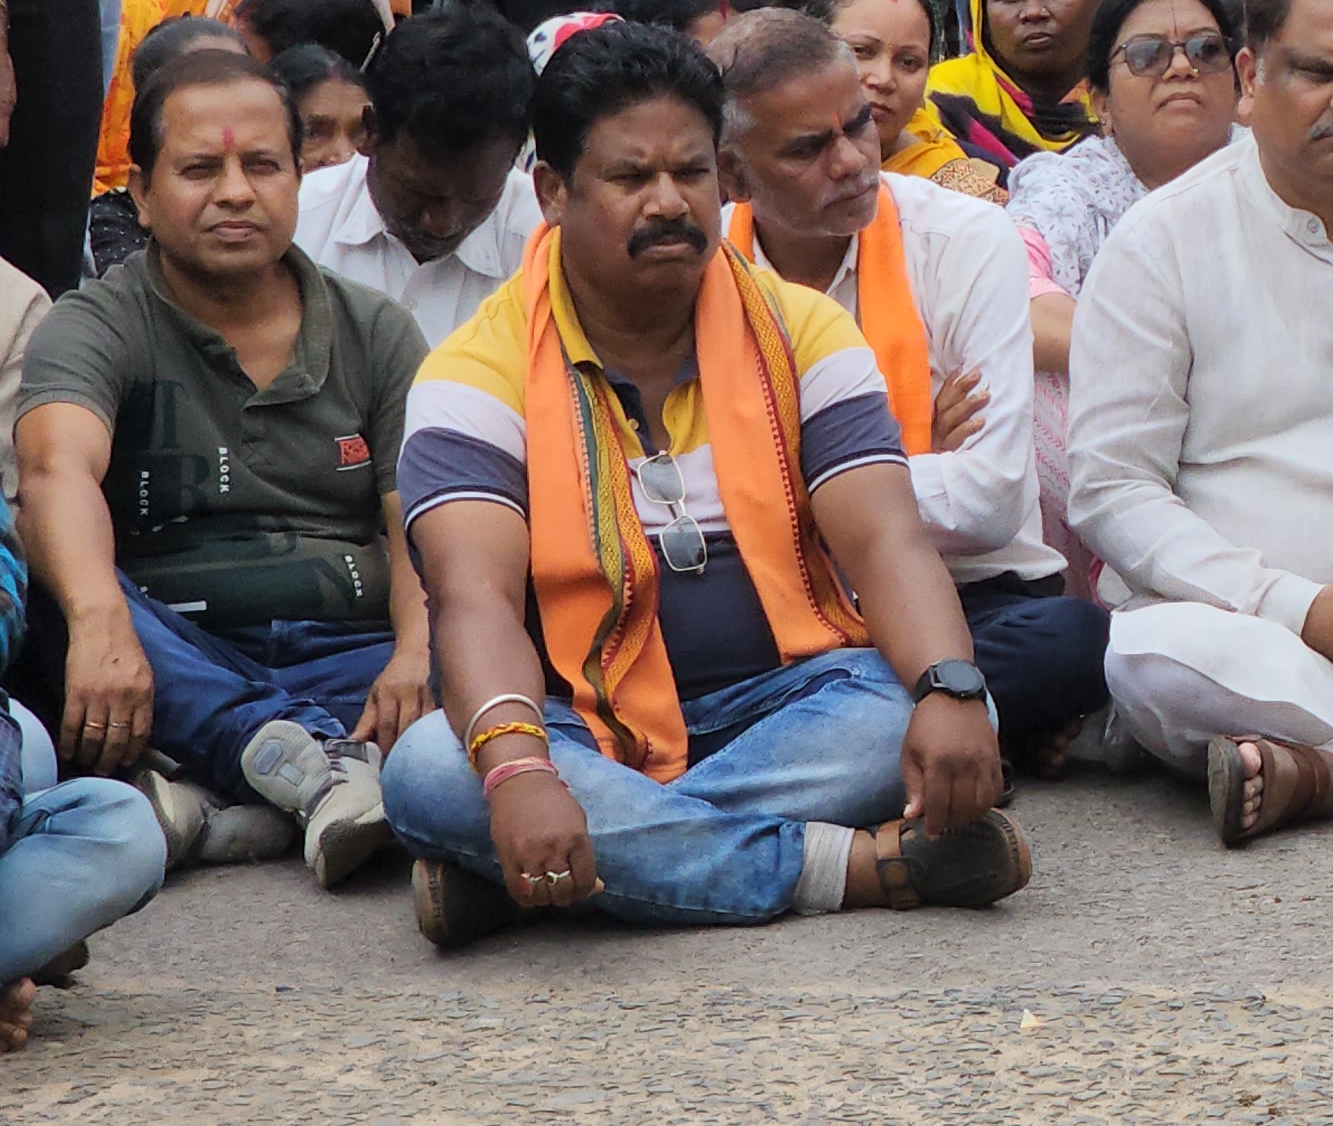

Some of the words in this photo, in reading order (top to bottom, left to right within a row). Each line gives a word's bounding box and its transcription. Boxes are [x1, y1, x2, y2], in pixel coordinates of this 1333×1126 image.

[138, 470, 150, 516] BLOCK
[218, 446, 230, 494] BLOCK
[344, 554, 364, 597] BLOCK
